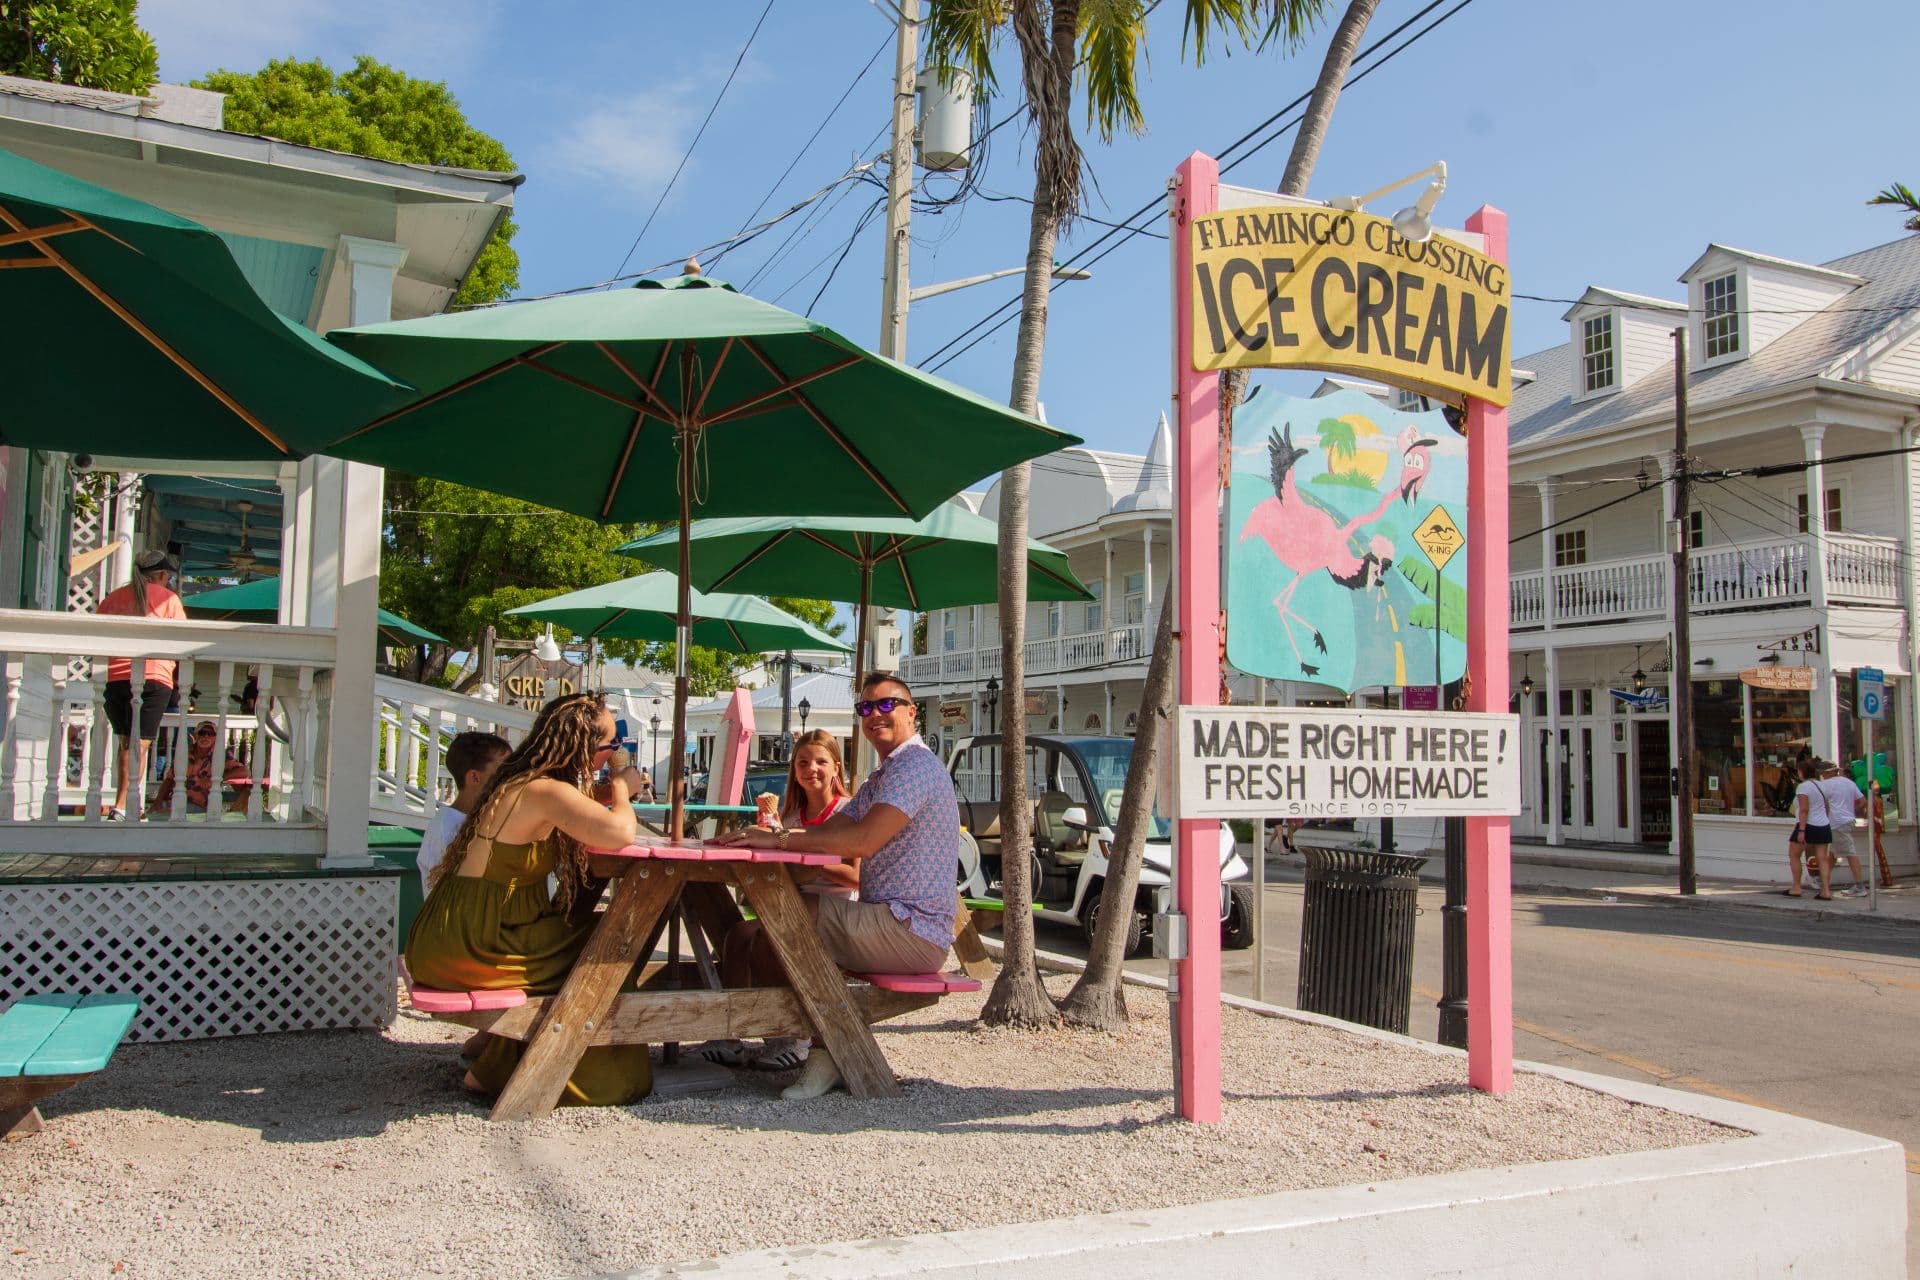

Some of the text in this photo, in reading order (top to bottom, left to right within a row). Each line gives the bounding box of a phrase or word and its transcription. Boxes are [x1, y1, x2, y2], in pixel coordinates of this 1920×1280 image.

[1195, 212, 1505, 296] FLAMINGO CROSSING
[1195, 256, 1508, 389] ICE CREAM
[1428, 545, 1451, 554] X-ING
[508, 675, 574, 697] GRAD
[1193, 719, 1290, 759] MADE
[1300, 723, 1397, 761] RIGHT
[1205, 764, 1489, 800] FRESH HOMEMADE
[1289, 802, 1408, 815] SINCE 1987
